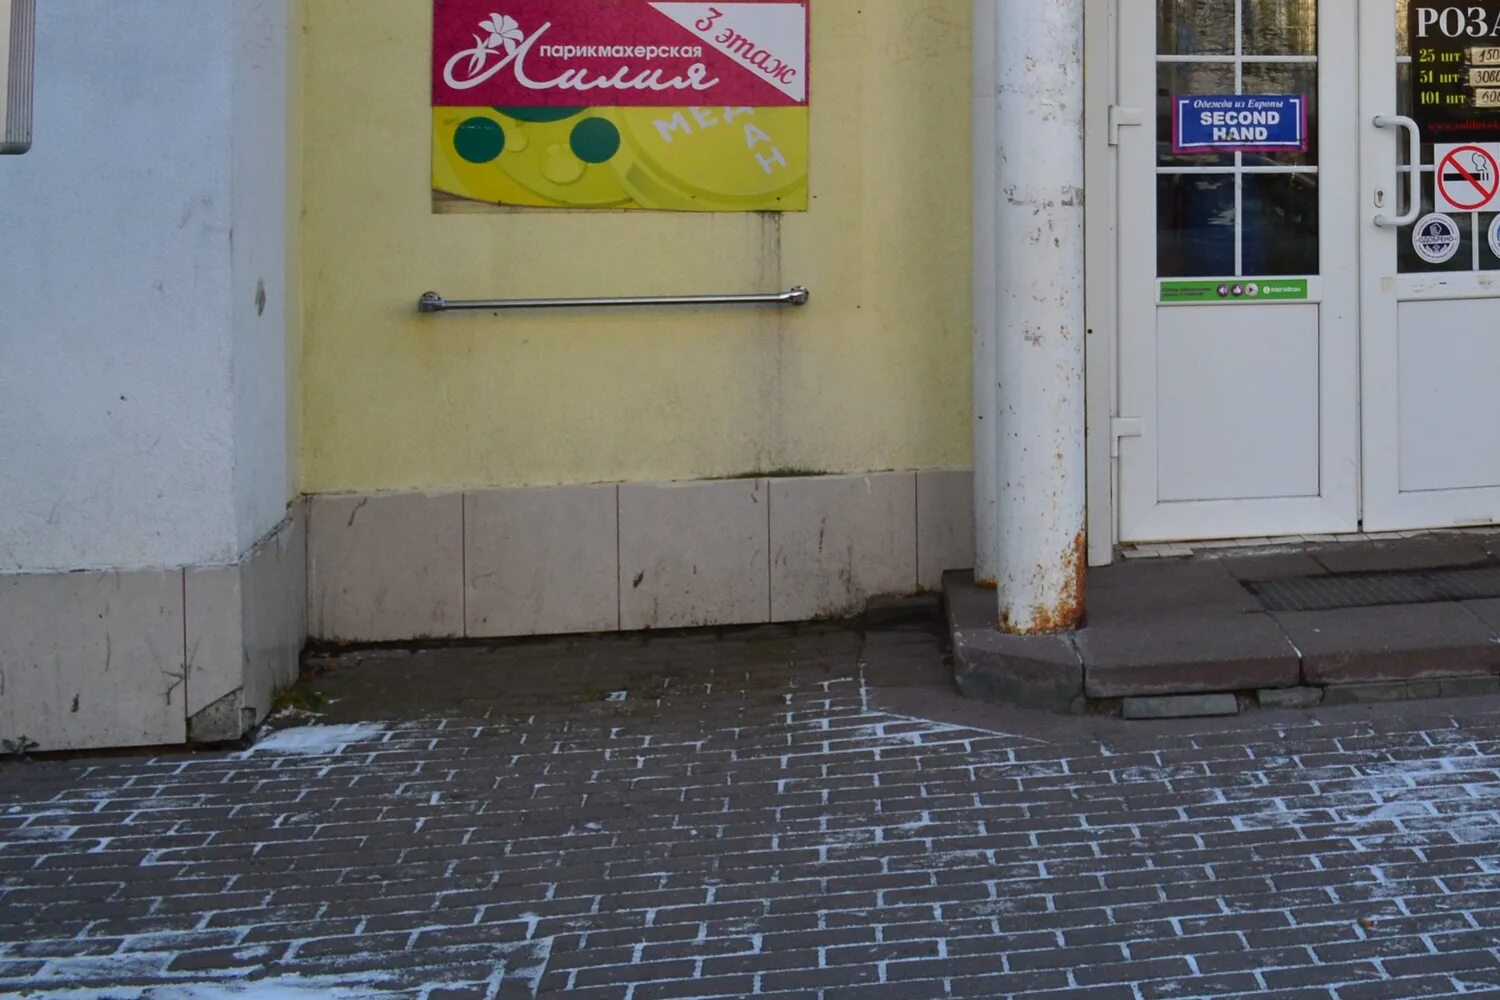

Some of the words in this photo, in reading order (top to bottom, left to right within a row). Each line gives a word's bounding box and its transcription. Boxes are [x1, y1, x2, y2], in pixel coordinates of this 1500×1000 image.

[540, 44, 702, 59] парикмахерская
[695, 7, 722, 32] 3
[715, 29, 796, 85] этаж
[444, 21, 720, 90] Лилия
[1419, 49, 1435, 62] 25
[1441, 51, 1461, 62] шт
[1420, 71, 1433, 83] 51
[1439, 72, 1460, 83] шт
[1193, 99, 1232, 108] Одежда
[1247, 99, 1283, 109] Европы
[1420, 91, 1439, 105] 101
[1446, 93, 1466, 104] шт
[1200, 111, 1280, 125] SECOND
[1213, 127, 1268, 140] HAND
